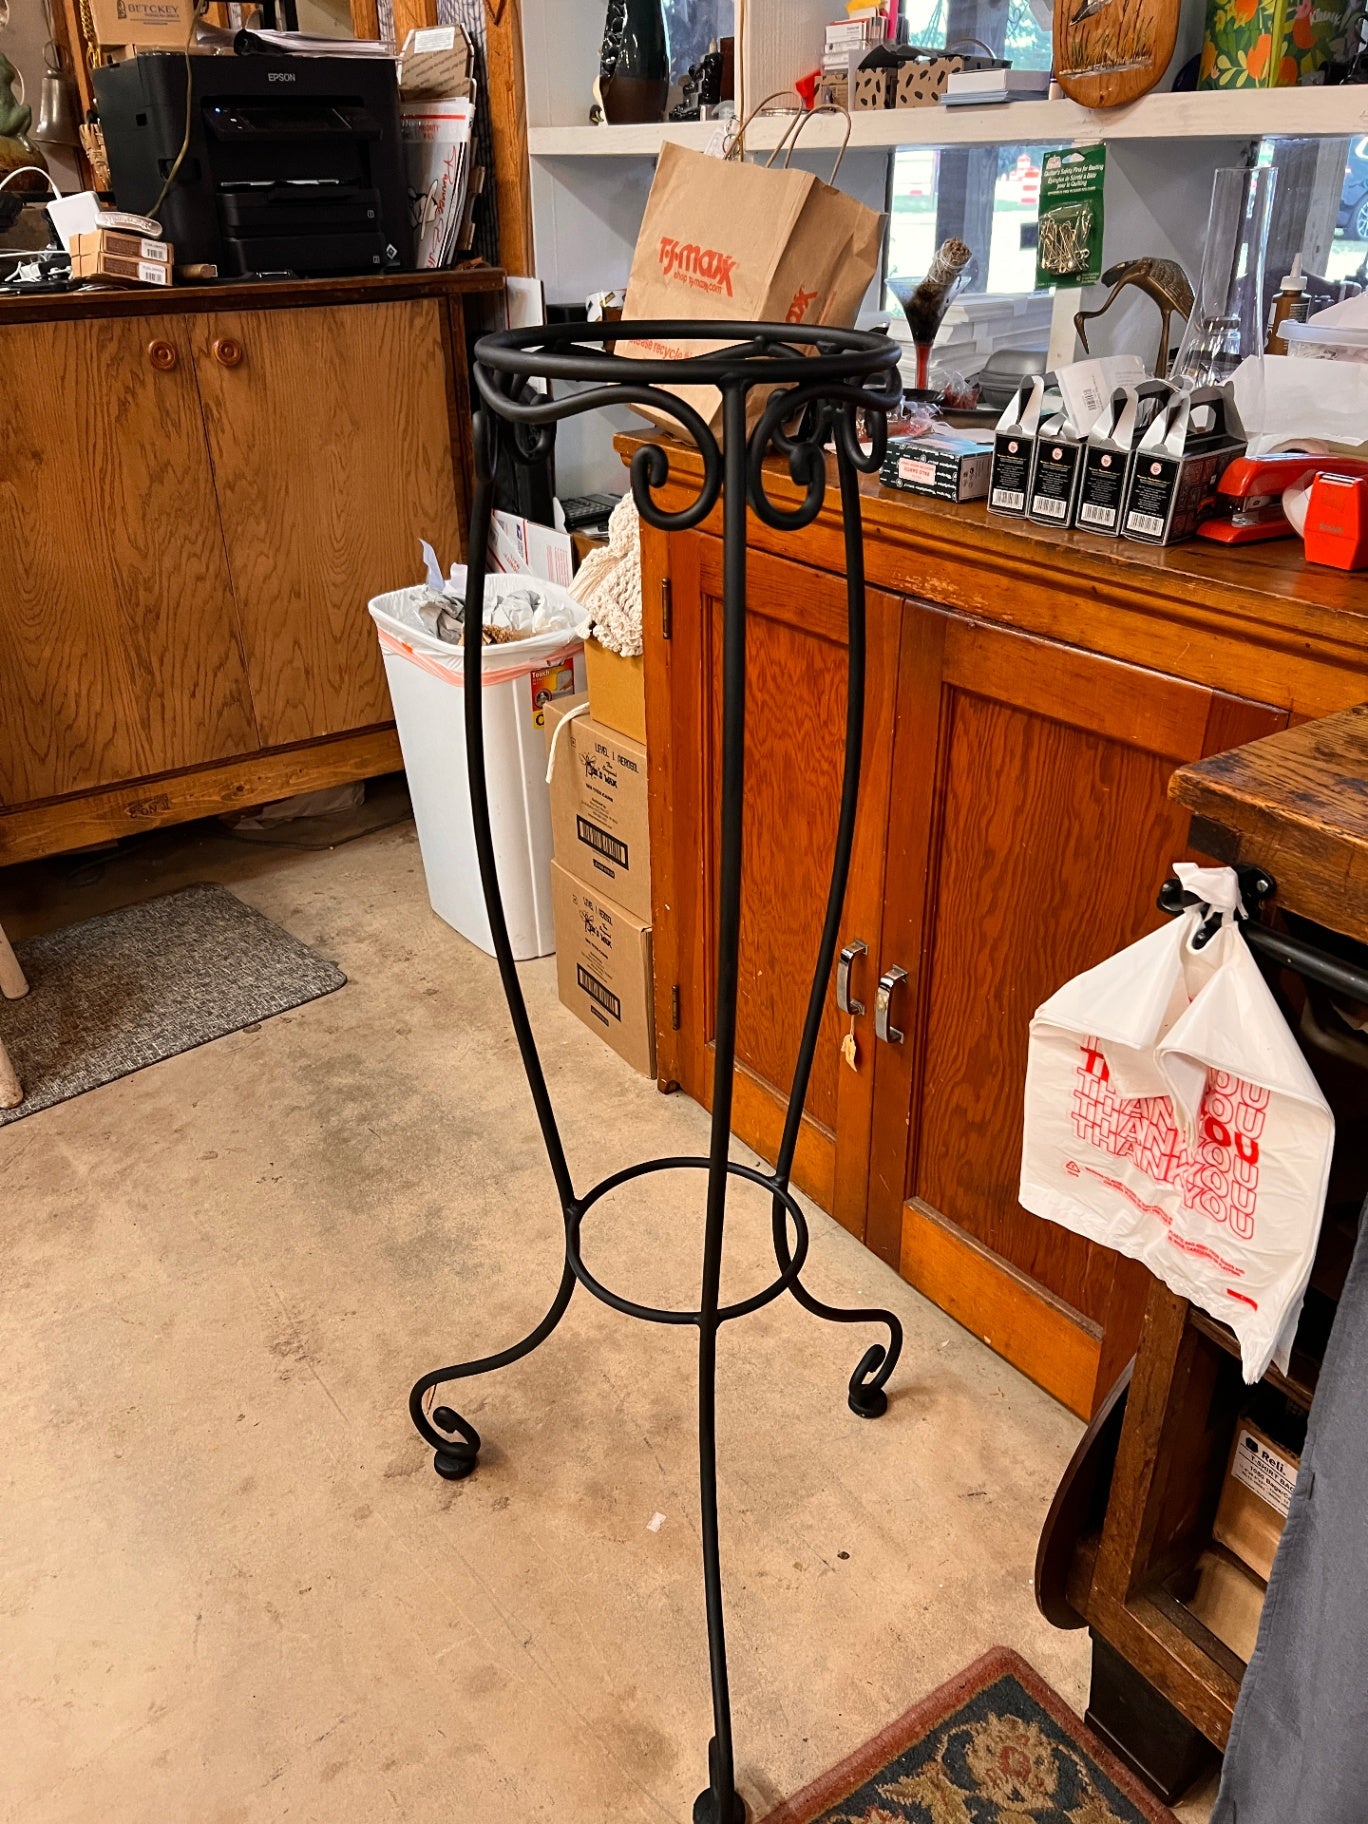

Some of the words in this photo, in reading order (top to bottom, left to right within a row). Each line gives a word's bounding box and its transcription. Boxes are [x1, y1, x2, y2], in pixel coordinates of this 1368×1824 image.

[128, 4, 178, 14] BETCKEY
[267, 72, 296, 82] EPSON
[594, 742, 610, 758] LEVEL
[617, 754, 639, 774] AEROSOL
[1076, 1066, 1178, 1134] THAN
[1204, 1090, 1266, 1140] OU
[1183, 1176, 1255, 1240] YOU
[1250, 1454, 1279, 1479] T-SHIRT
